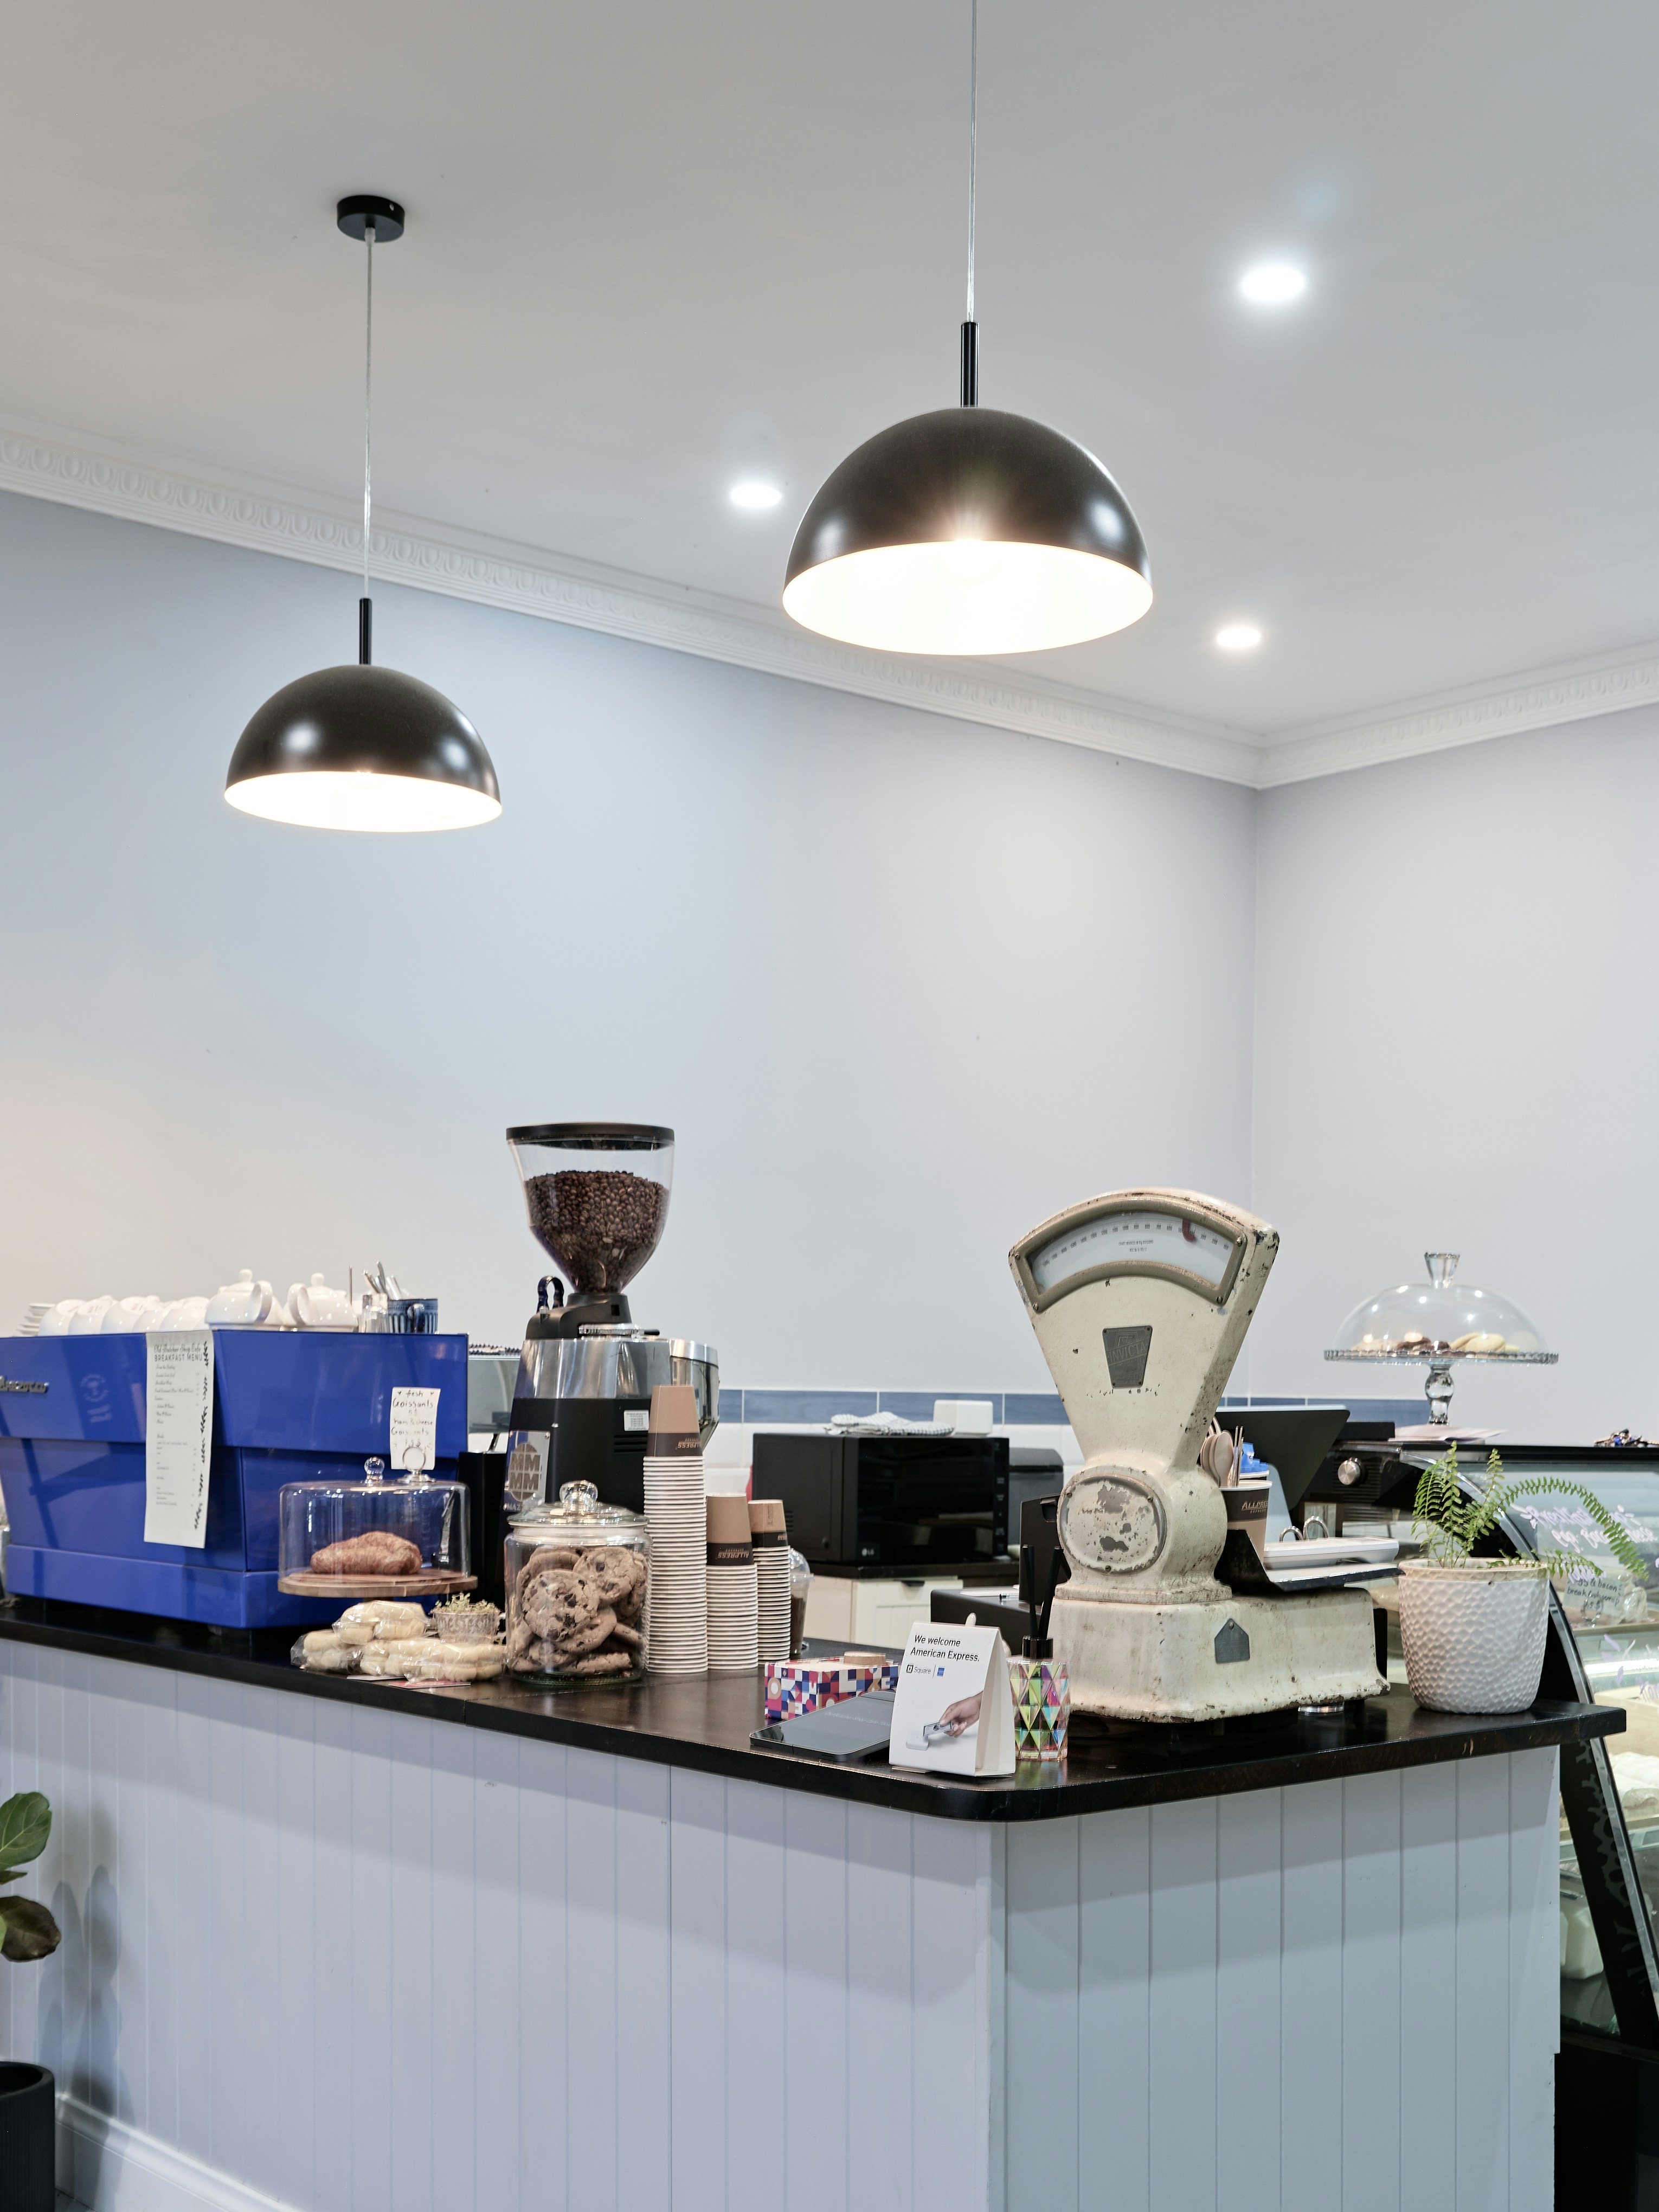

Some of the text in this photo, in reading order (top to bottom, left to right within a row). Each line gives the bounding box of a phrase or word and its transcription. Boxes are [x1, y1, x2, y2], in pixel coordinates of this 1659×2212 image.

[1109, 1341, 1146, 1362] INVICTA
[155, 1354, 185, 1362] BREAKFAST
[406, 1389, 423, 1398] fresh
[1242, 1500, 1268, 1510] ALLPRES
[718, 1551, 749, 1559] ALLPRESS
[1598, 1577, 1617, 1592] bacon
[914, 1635, 961, 1647] We welcome
[910, 1647, 980, 1662] American Express.
[914, 1667, 931, 1675] Square
